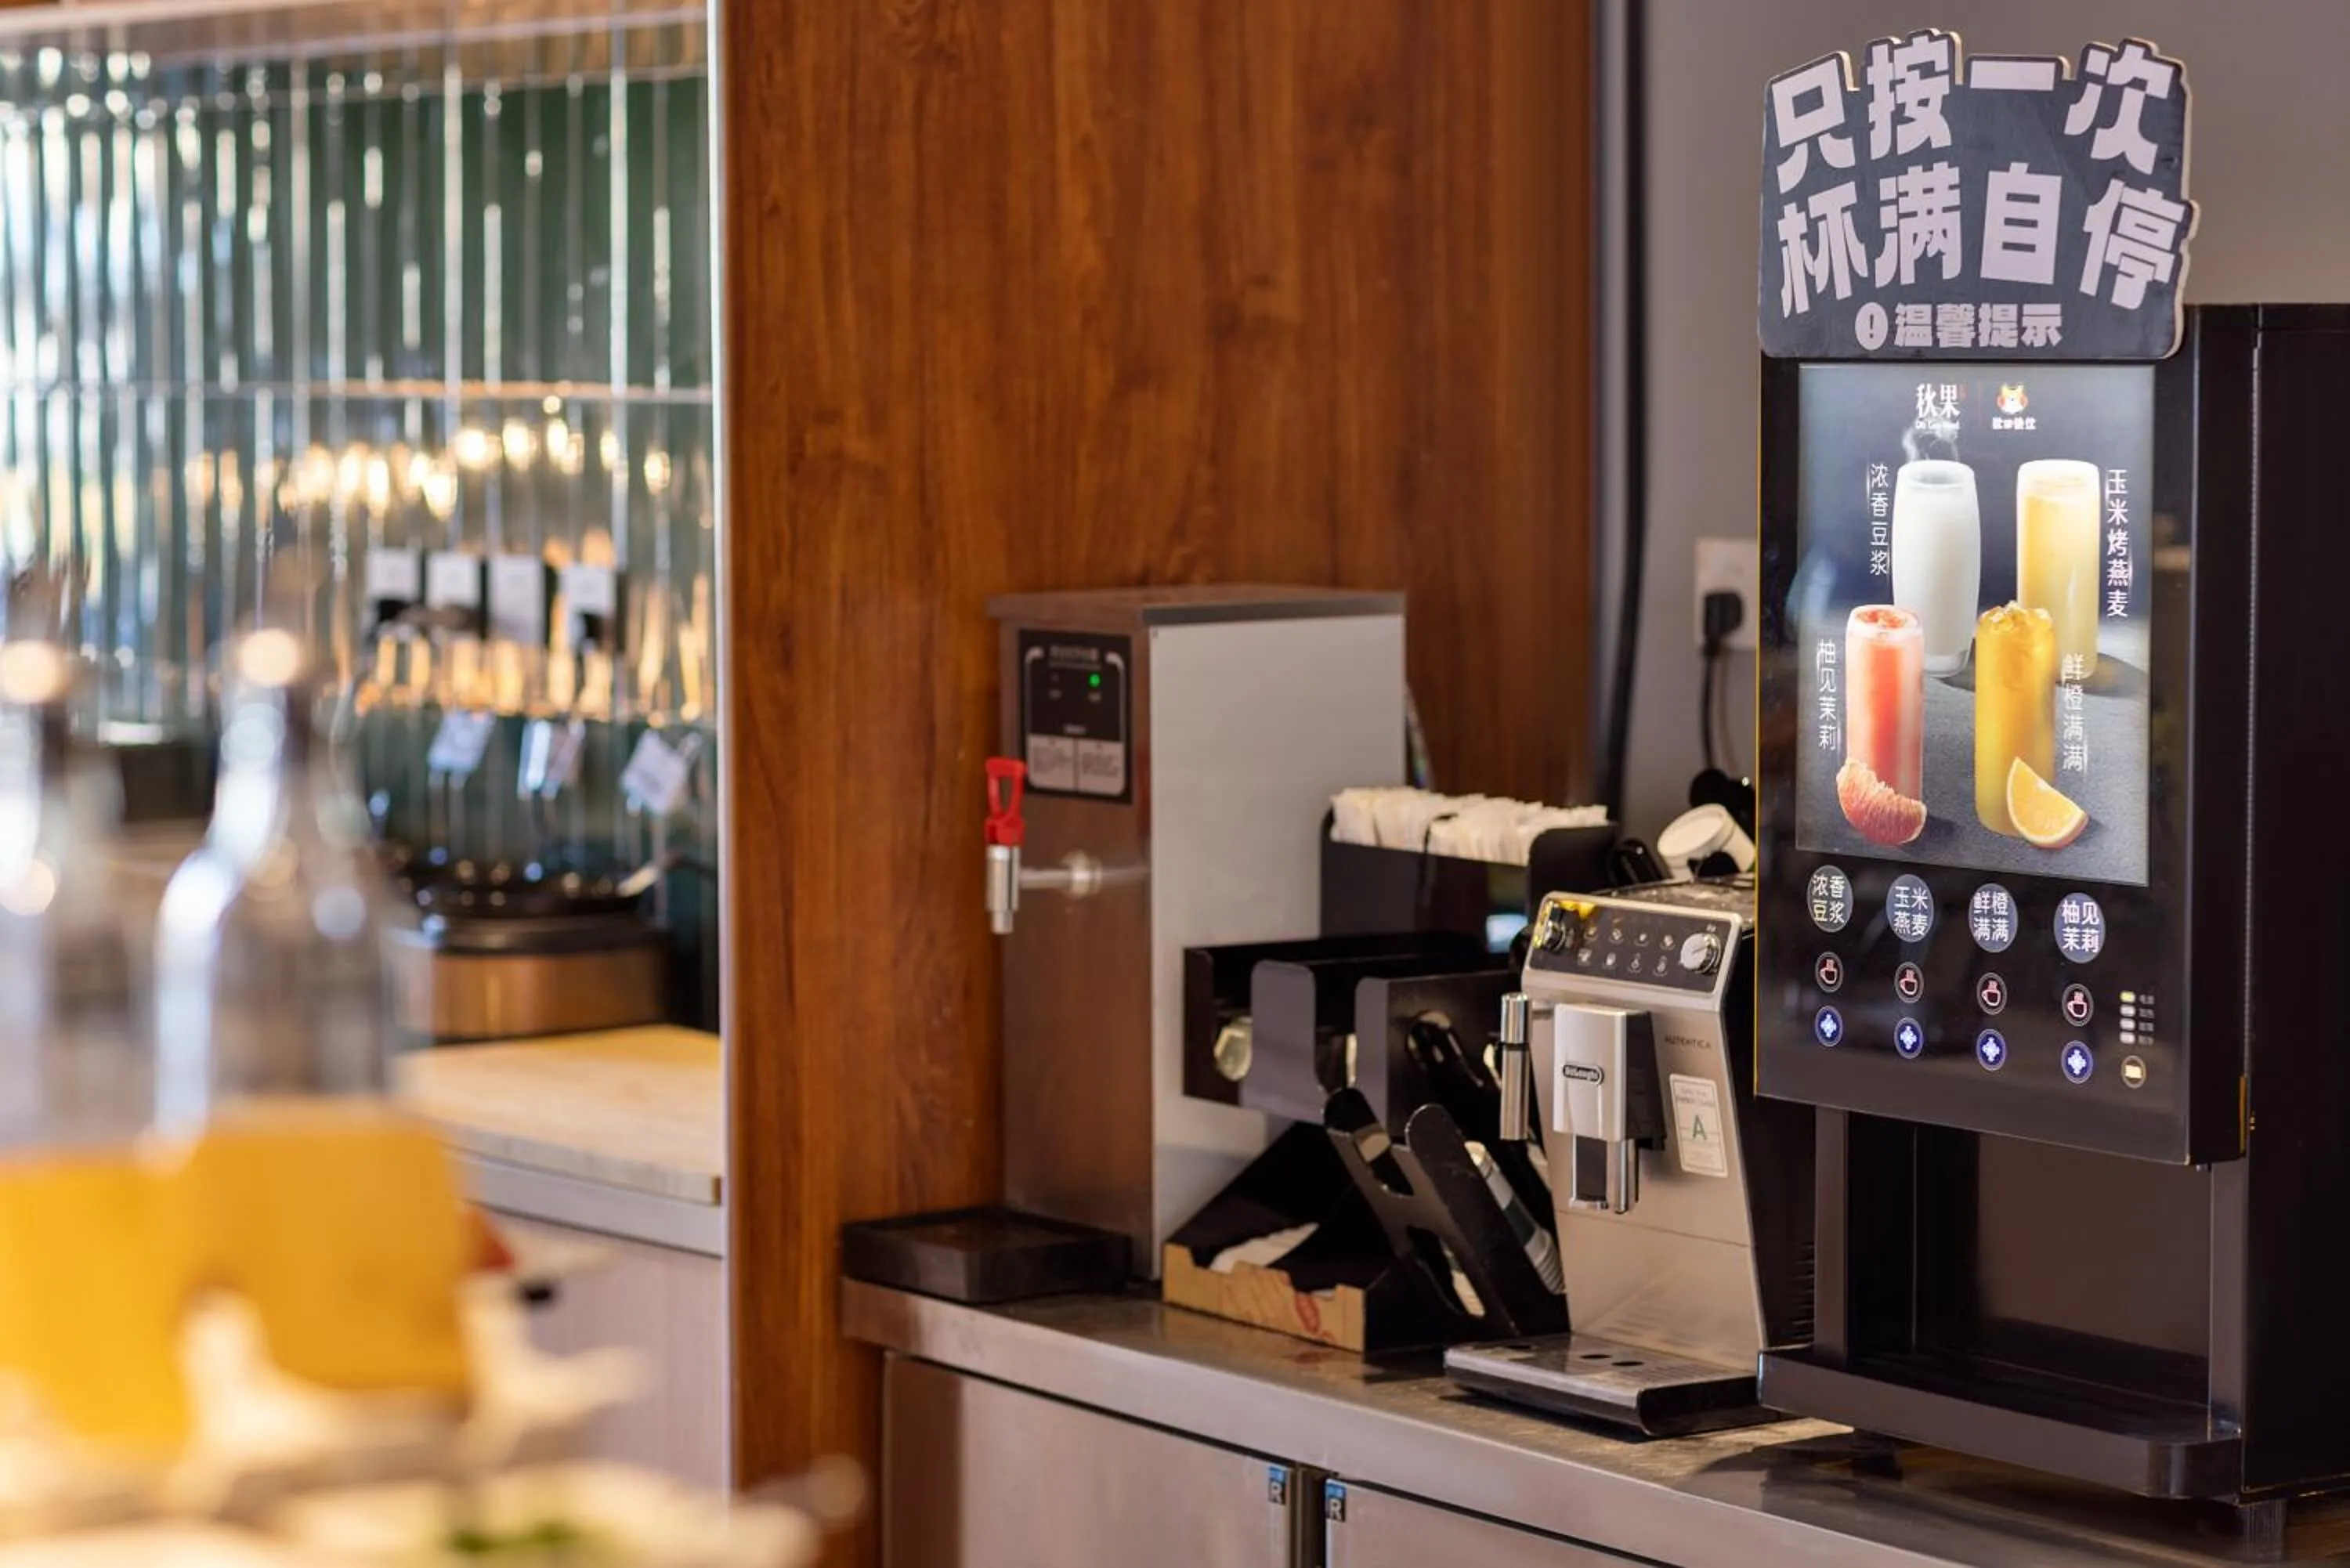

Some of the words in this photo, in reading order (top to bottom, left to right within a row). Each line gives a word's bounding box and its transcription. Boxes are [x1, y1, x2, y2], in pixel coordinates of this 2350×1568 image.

[1771, 35, 2174, 194] 只按一次
[1777, 161, 2186, 319] 杯满自停
[1894, 302, 2063, 348] 温馨提示
[1915, 383, 1961, 418] 秋果
[1870, 463, 1889, 576] 浓香豆浆
[2106, 469, 2129, 617] 玉米烤燕麦
[2063, 652, 2084, 772] 鲜橙满满
[1812, 874, 1845, 898] 浓香
[1894, 886, 1928, 910] 玉米
[1812, 899, 1845, 923] 豆浆
[1973, 891, 2009, 916] 鲜橙
[2062, 899, 2100, 926] 柚见
[1893, 910, 1928, 936] 燕麦
[1973, 917, 2009, 942] 满满
[2062, 927, 2100, 953] 茉莉
[1692, 1115, 1708, 1141] A
[1271, 1480, 1282, 1503] R
[1329, 1498, 1342, 1521] R
